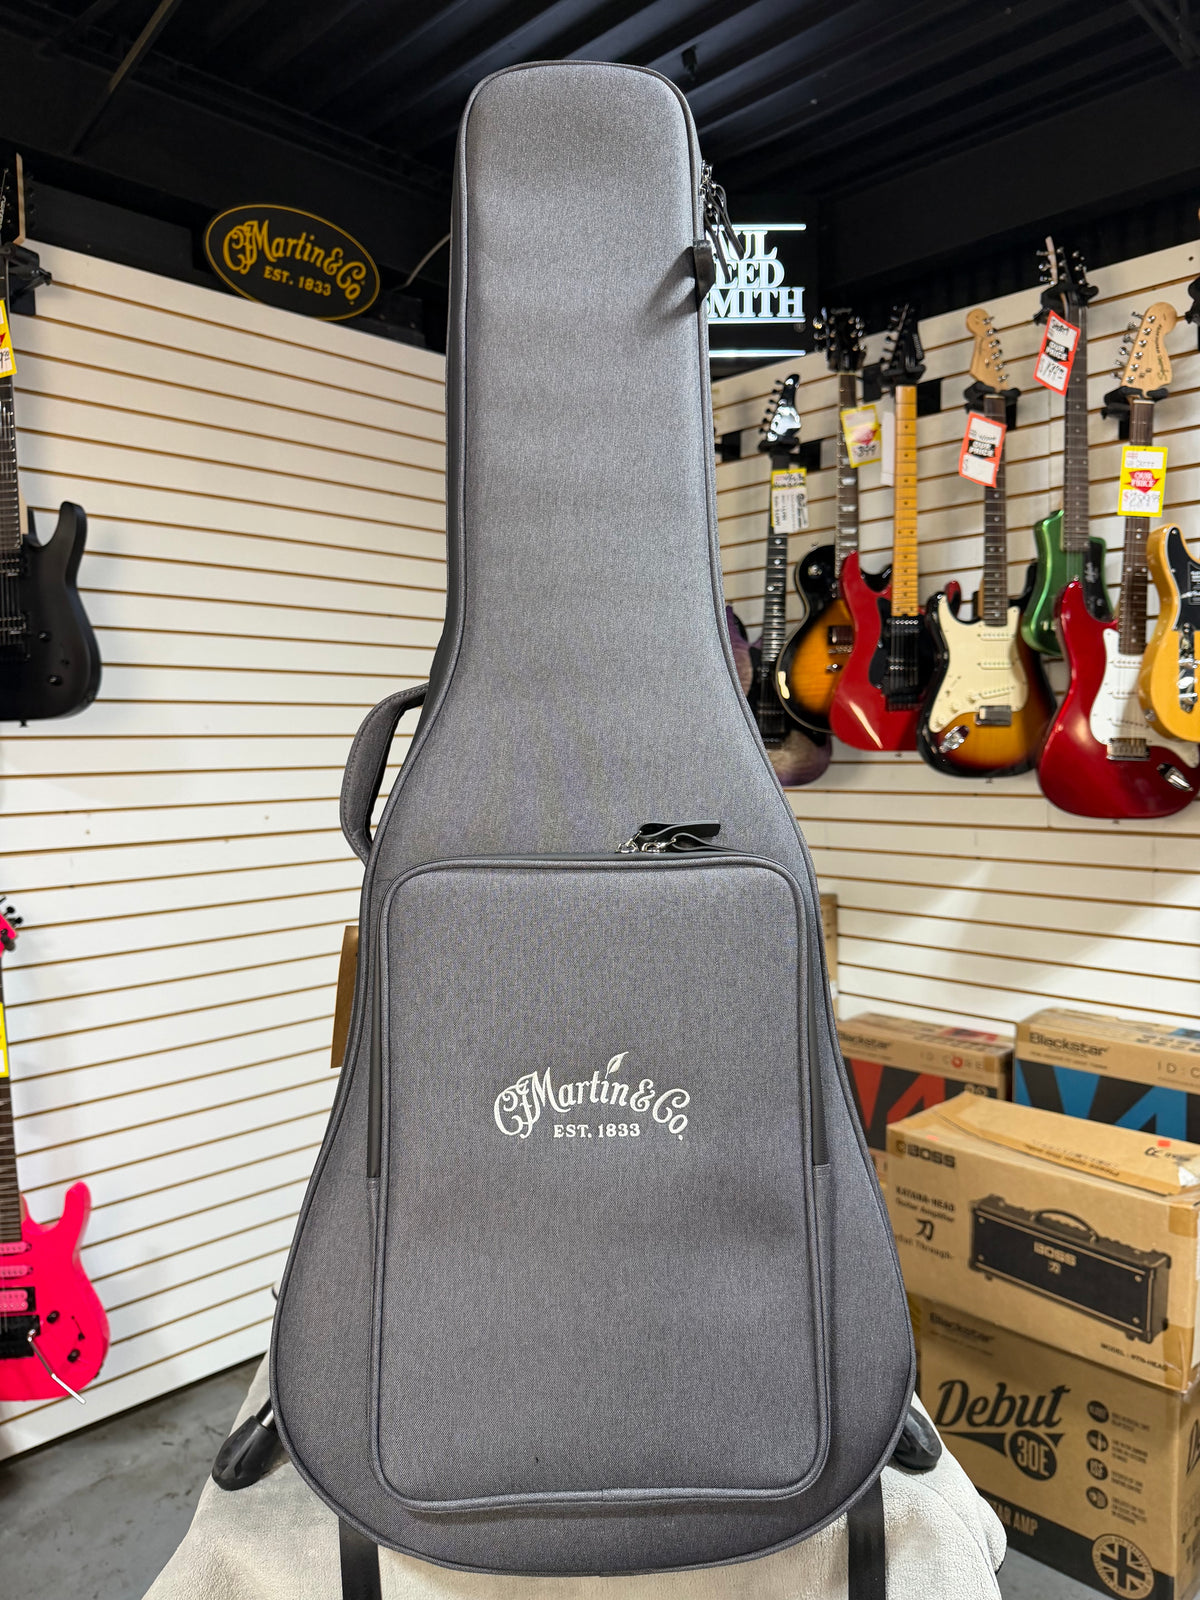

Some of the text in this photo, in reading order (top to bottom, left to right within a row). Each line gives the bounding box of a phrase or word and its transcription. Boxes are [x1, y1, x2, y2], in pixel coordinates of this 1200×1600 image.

[298, 276, 332, 297] 1833
[714, 258, 785, 289] EED
[1029, 1032, 1109, 1057] Blackstar
[553, 1123, 641, 1138] EST. 1833
[907, 1143, 956, 1169] BOSS
[1033, 1241, 1077, 1268] BOSS
[935, 1379, 1072, 1428] Debut
[1017, 1438, 1050, 1478] 30E
